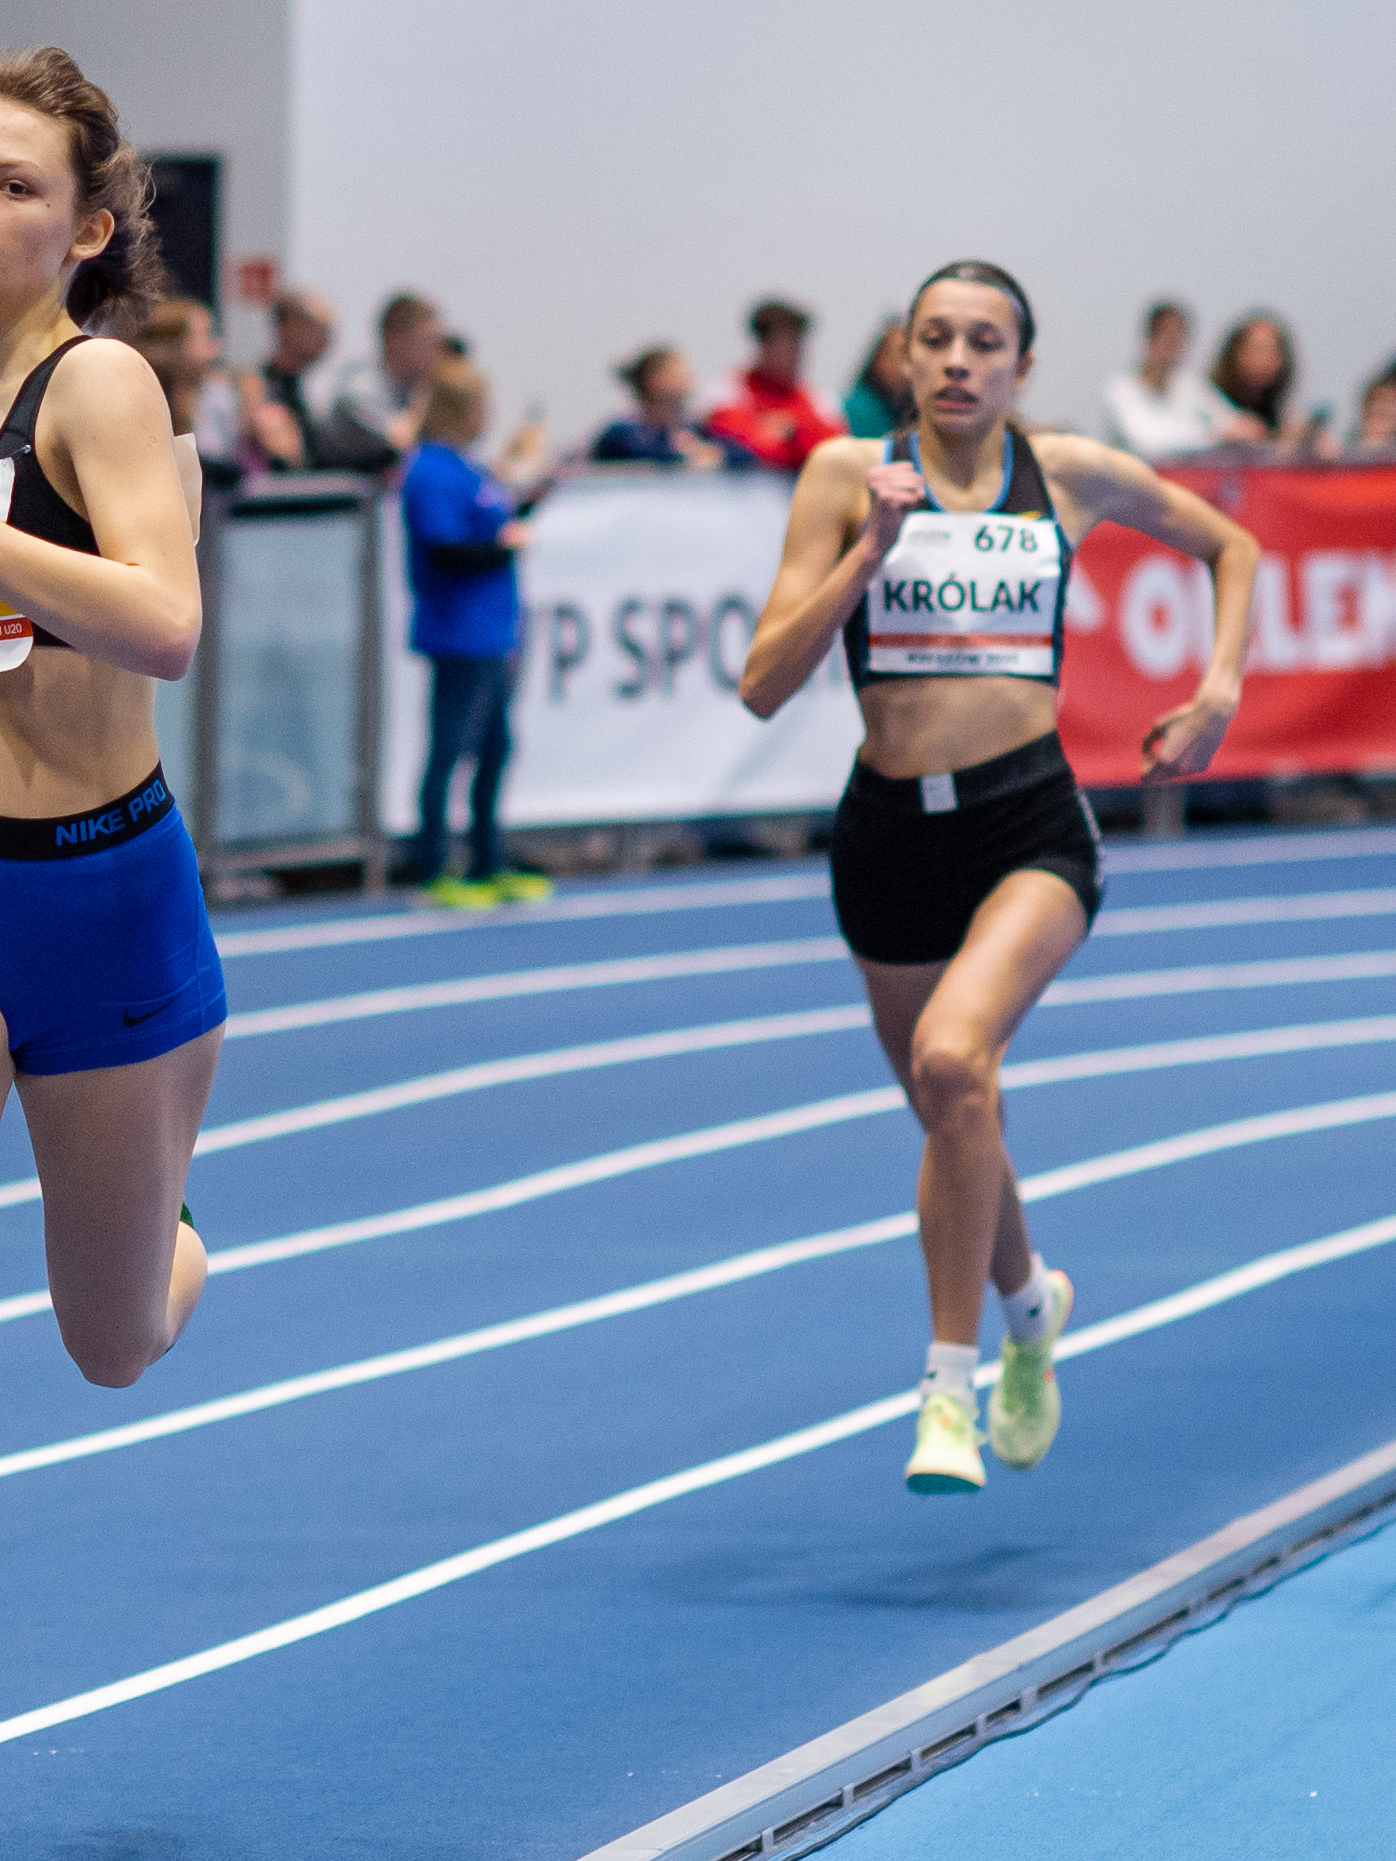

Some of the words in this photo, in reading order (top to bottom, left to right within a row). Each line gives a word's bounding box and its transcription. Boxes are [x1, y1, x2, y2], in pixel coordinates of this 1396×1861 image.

[974, 523, 1038, 552] 678
[882, 572, 1043, 613] KRÓLAK
[4, 622, 23, 635] U20
[55, 808, 125, 847] NIKE
[128, 779, 166, 823] PRO
